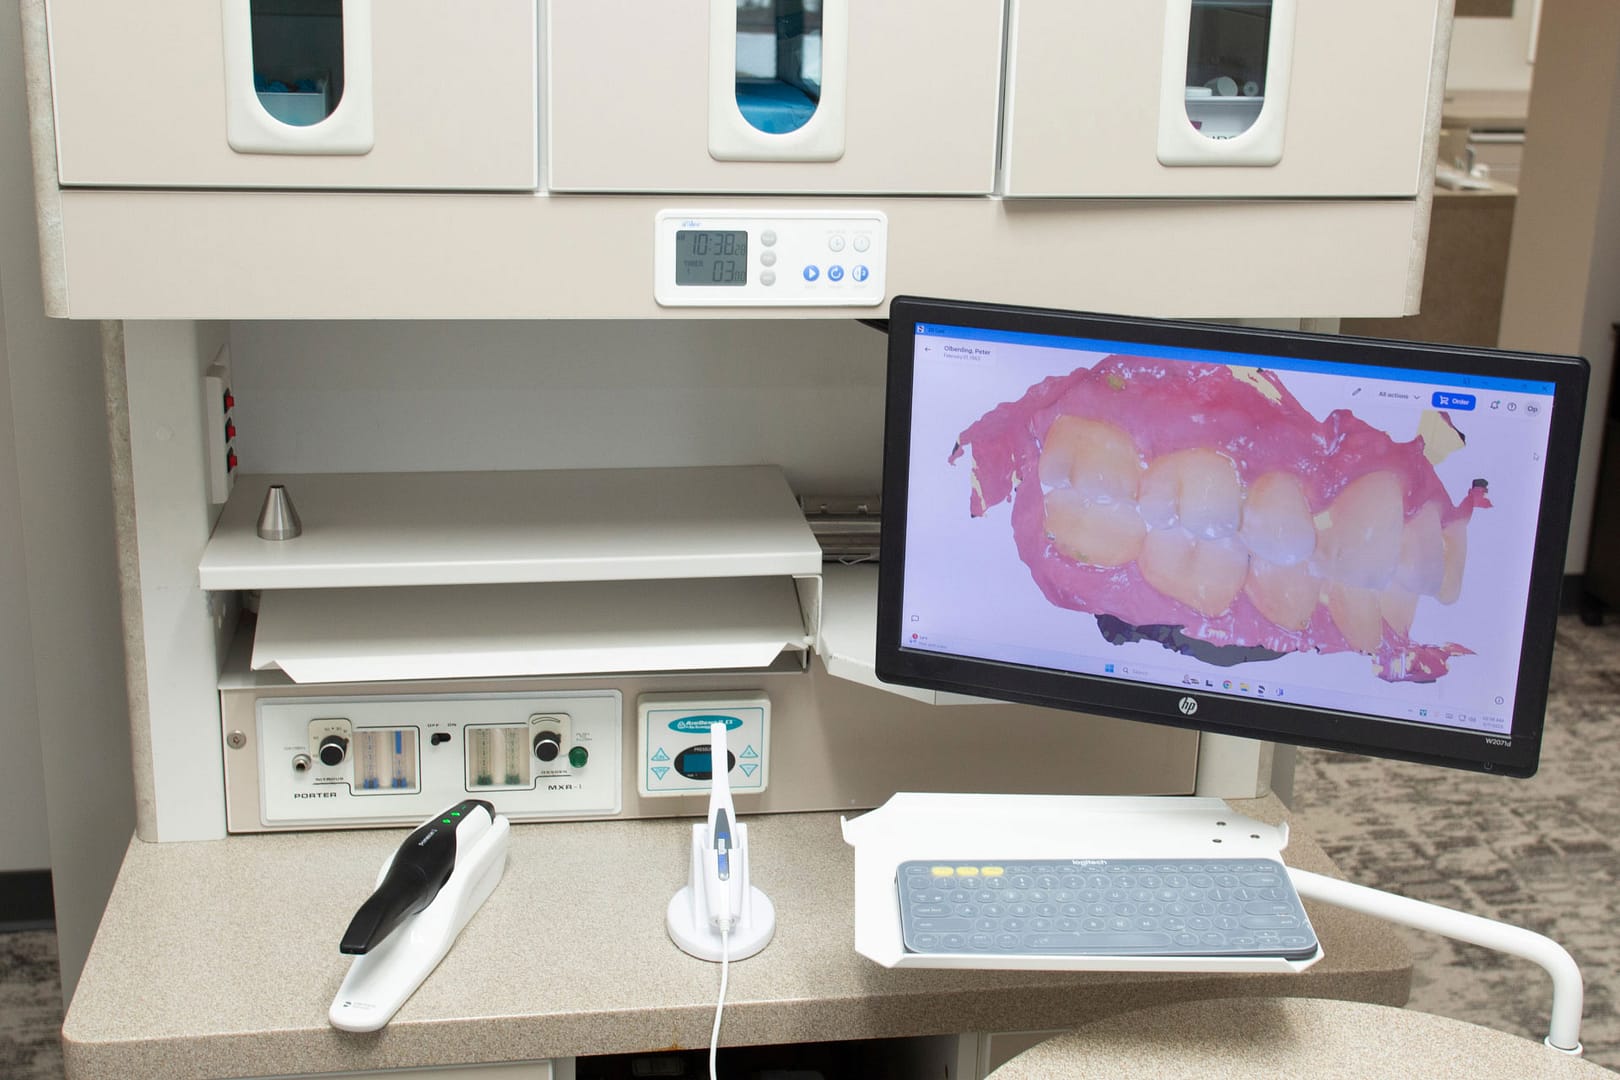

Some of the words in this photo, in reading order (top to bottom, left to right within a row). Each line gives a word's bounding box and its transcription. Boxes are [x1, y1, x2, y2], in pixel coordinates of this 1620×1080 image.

[693, 233, 735, 256] 10:38
[712, 260, 735, 282] 03
[1378, 390, 1389, 398] All
[1389, 391, 1409, 401] actions
[1452, 397, 1470, 406] Order
[1180, 697, 1197, 715] hp
[1072, 858, 1107, 867] logitech
